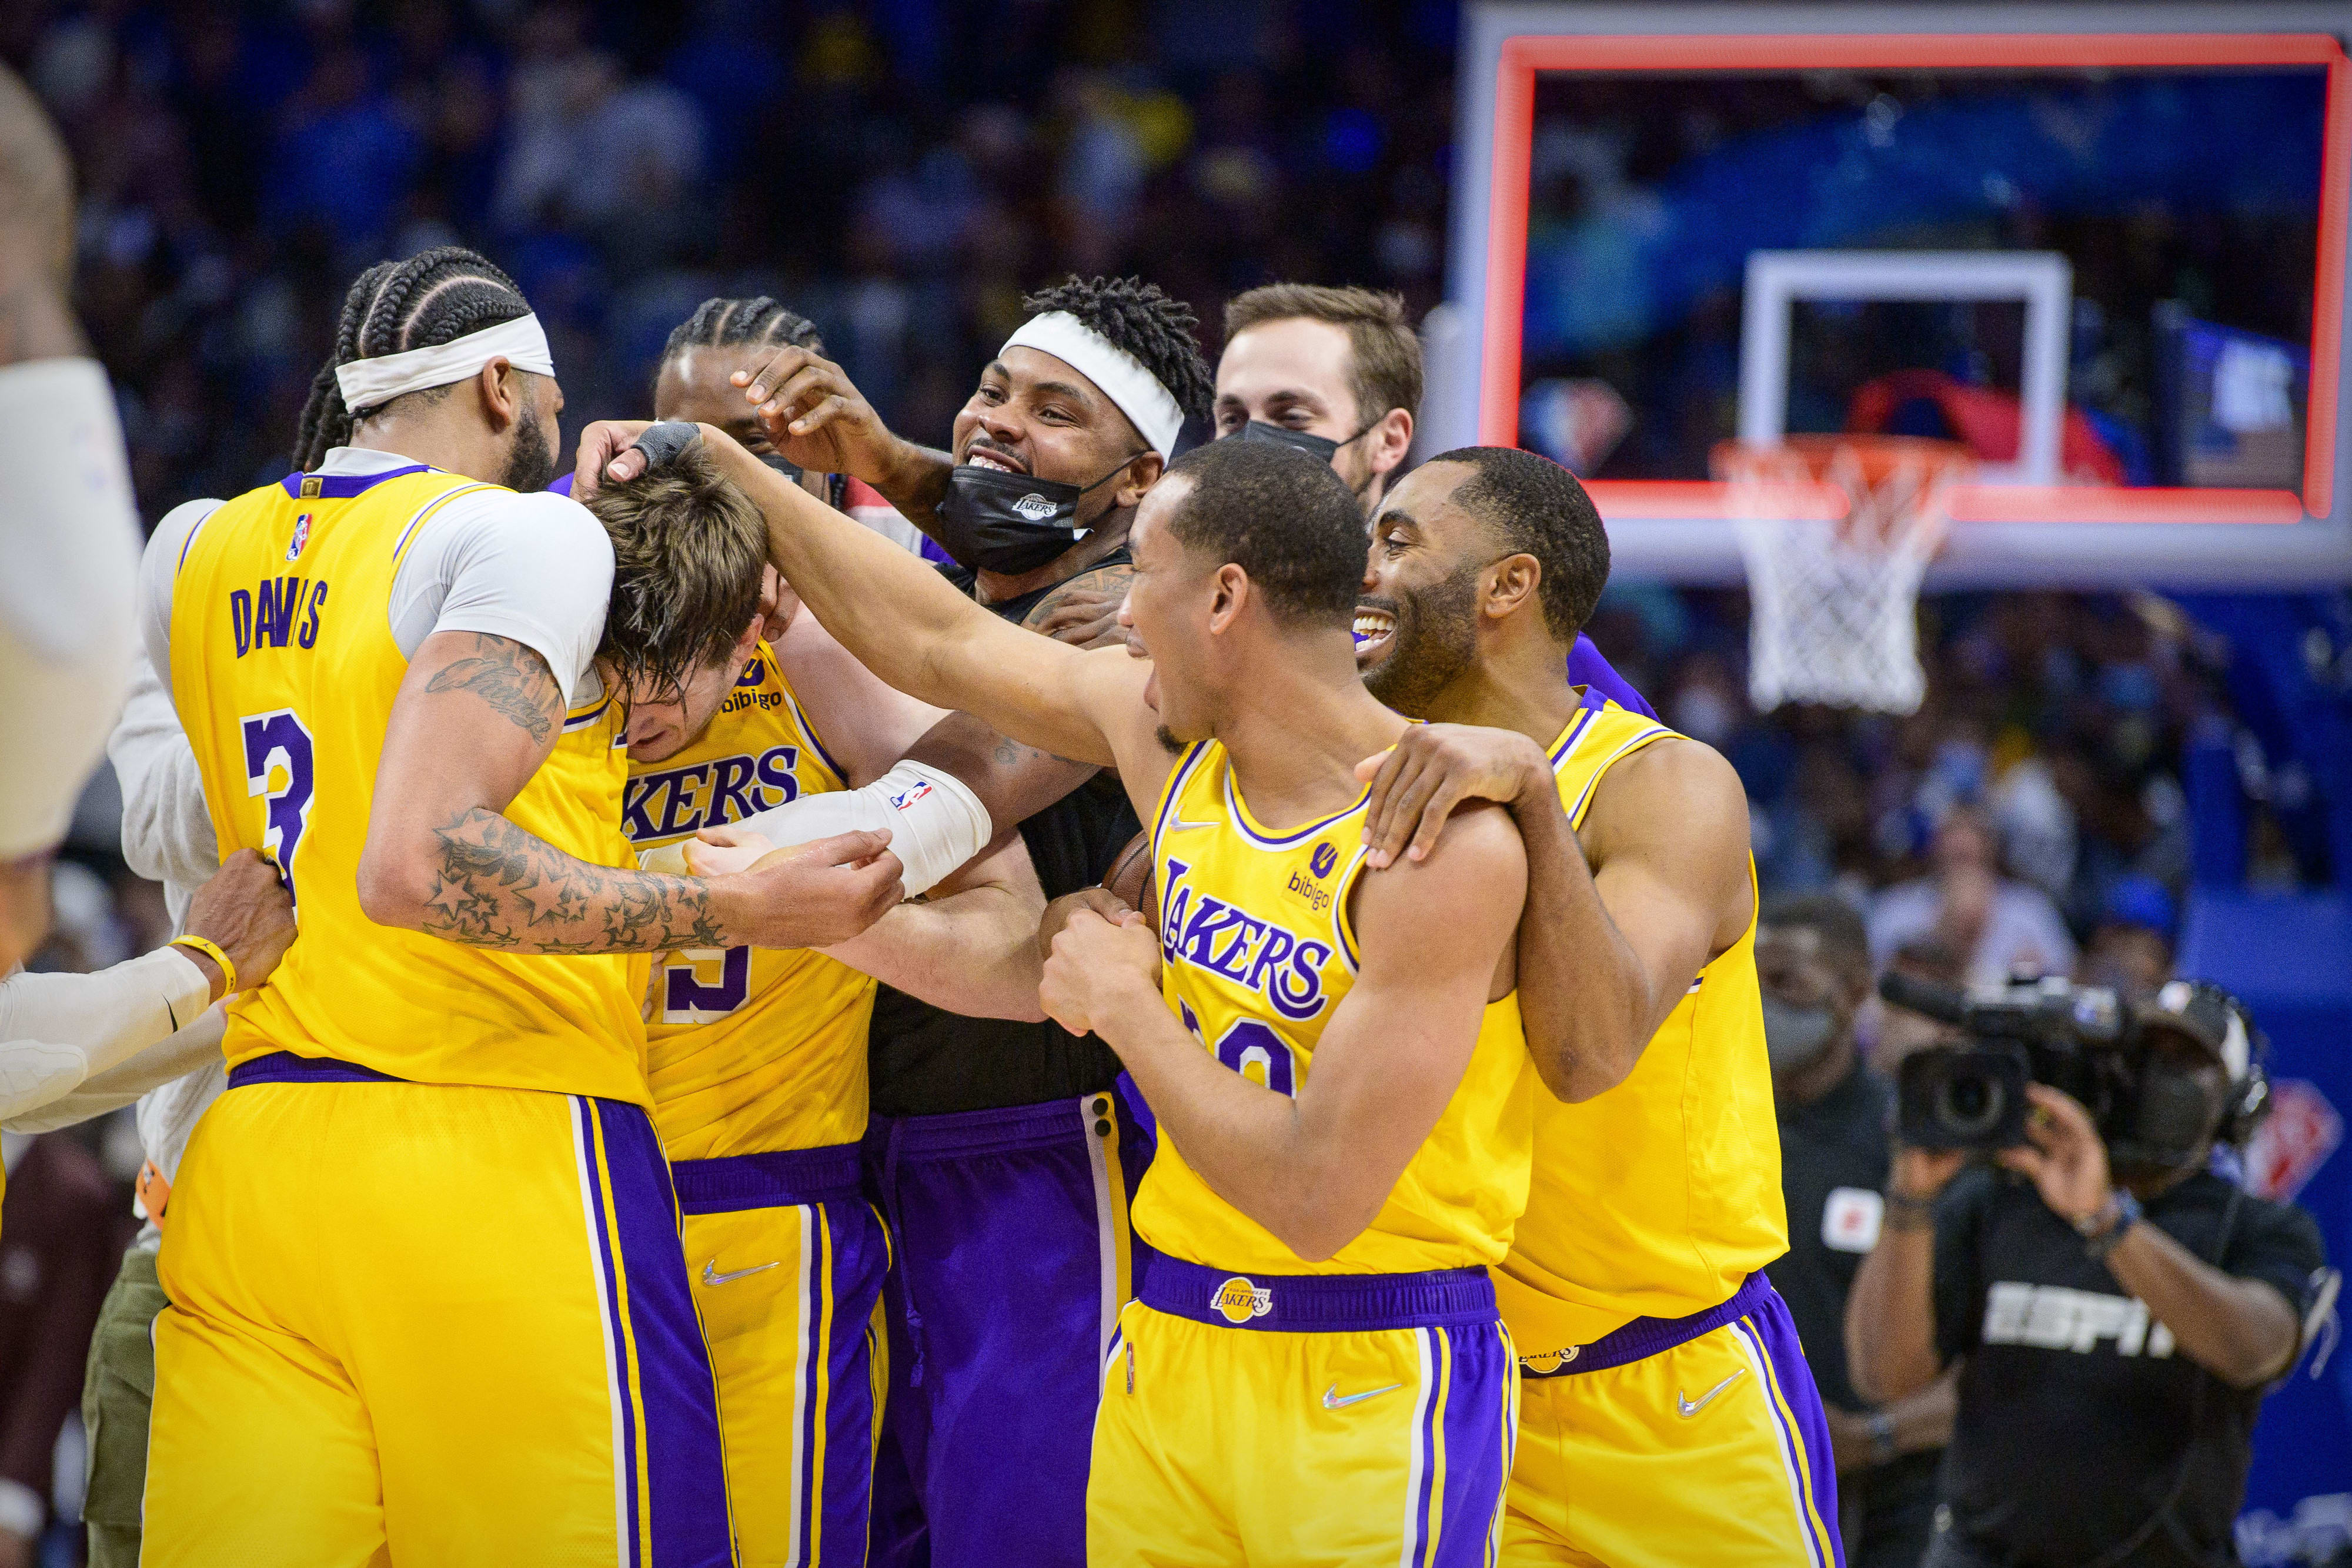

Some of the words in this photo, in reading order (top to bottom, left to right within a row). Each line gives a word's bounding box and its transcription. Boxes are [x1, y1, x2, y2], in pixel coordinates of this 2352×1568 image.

[1017, 499, 1054, 515] LAKERS
[230, 577, 328, 658] DAVIS
[239, 707, 313, 911] 3
[620, 745, 808, 842] KERS
[1288, 871, 1329, 910] bibigo
[1162, 855, 1335, 1022] LAKERS
[1215, 1287, 1268, 1313] LAKERS
